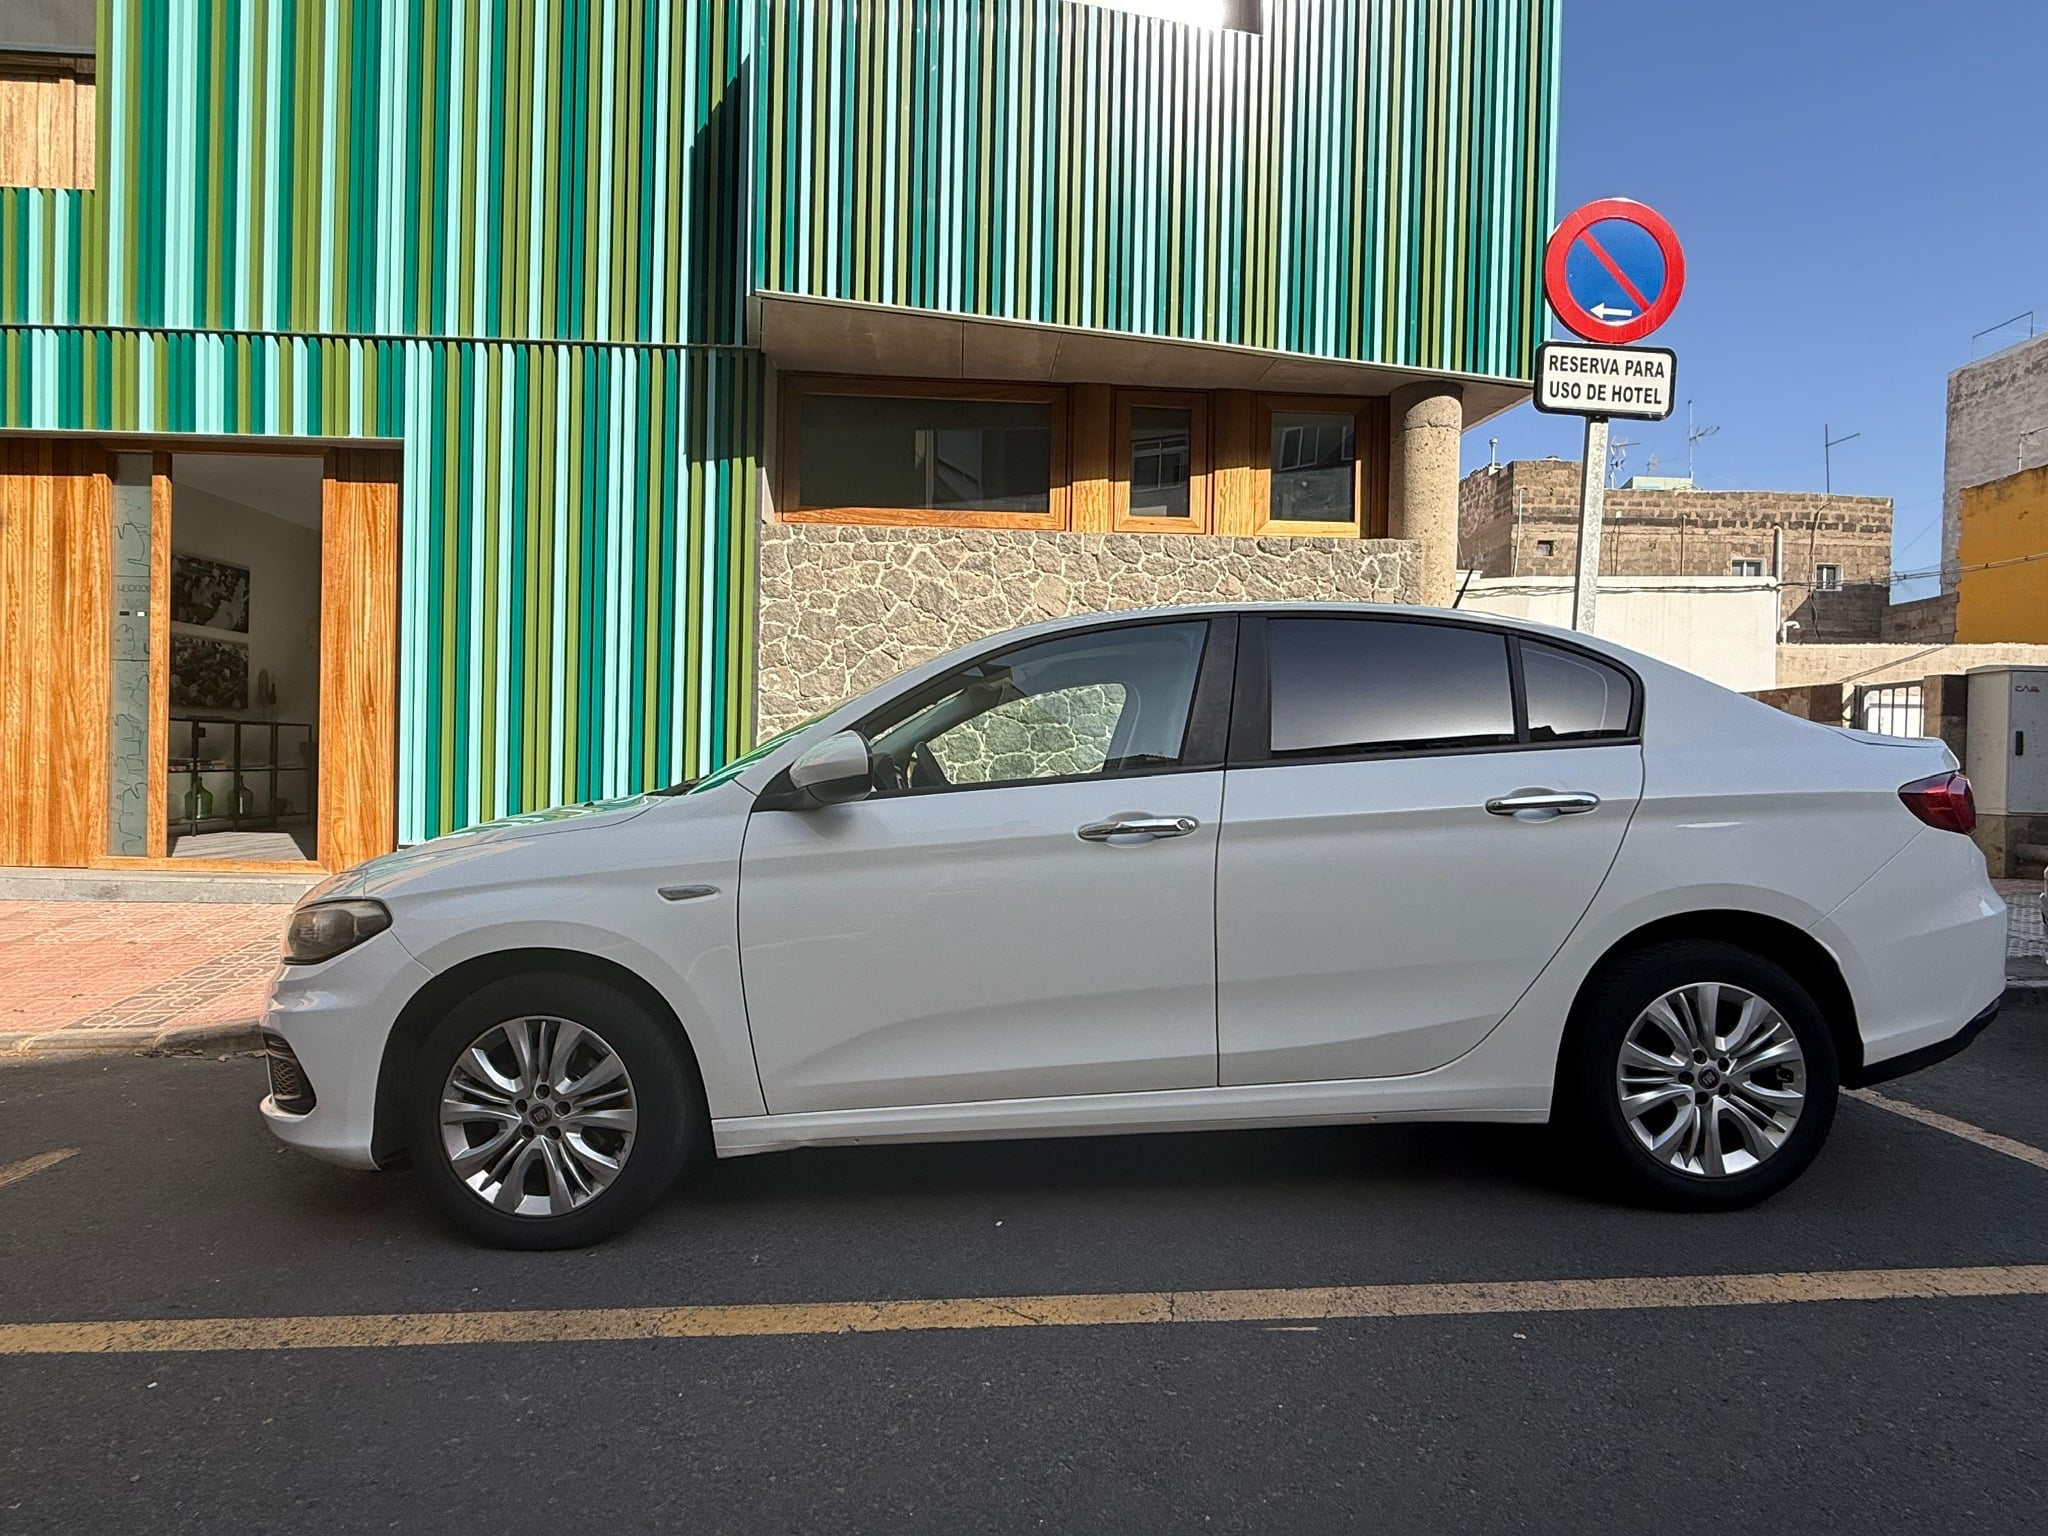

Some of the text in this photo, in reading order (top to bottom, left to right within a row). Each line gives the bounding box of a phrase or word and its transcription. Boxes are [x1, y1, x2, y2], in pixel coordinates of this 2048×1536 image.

[1549, 355, 1664, 378] RESERVA PARA
[1549, 381, 1662, 404] USO DE HOTEL
